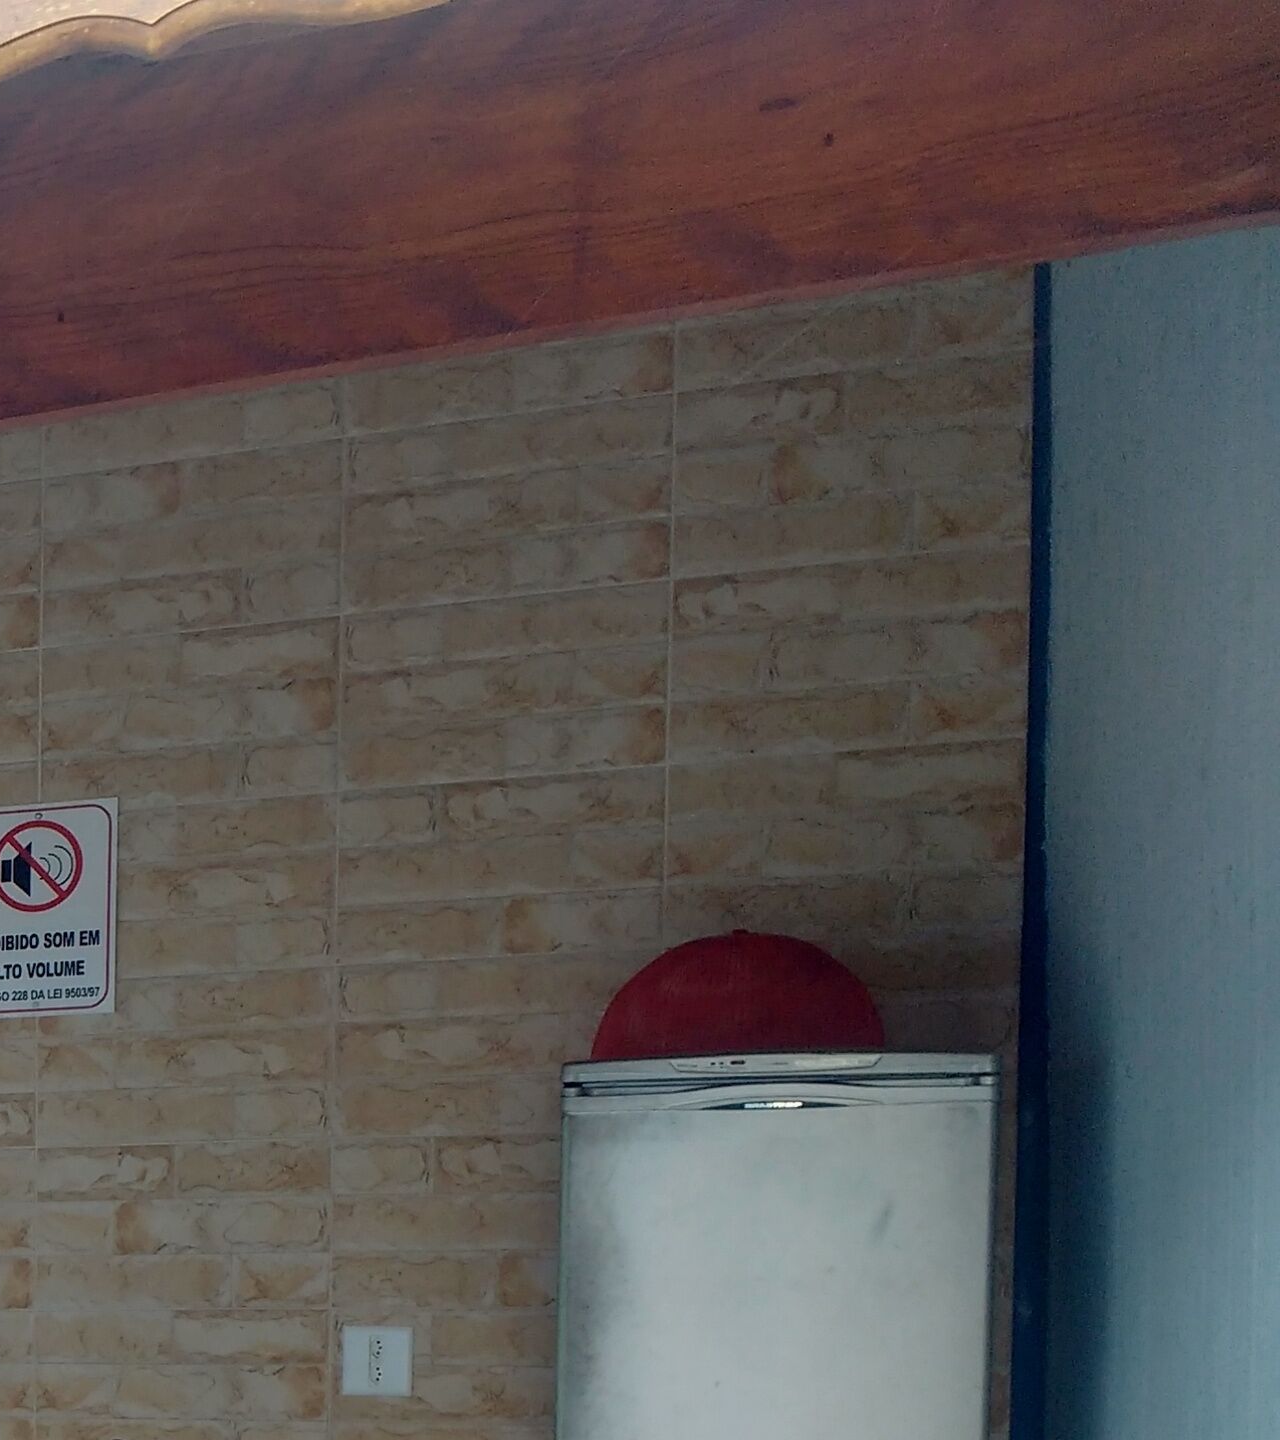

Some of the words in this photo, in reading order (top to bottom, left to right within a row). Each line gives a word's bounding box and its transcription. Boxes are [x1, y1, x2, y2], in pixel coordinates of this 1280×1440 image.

[43, 931, 75, 949] SOM
[79, 929, 100, 947] EM
[26, 960, 85, 979] VOLUME
[11, 989, 28, 1001] 228
[31, 988, 45, 1000] DA
[47, 987, 62, 999] LEI
[64, 986, 100, 999] 9503/97
